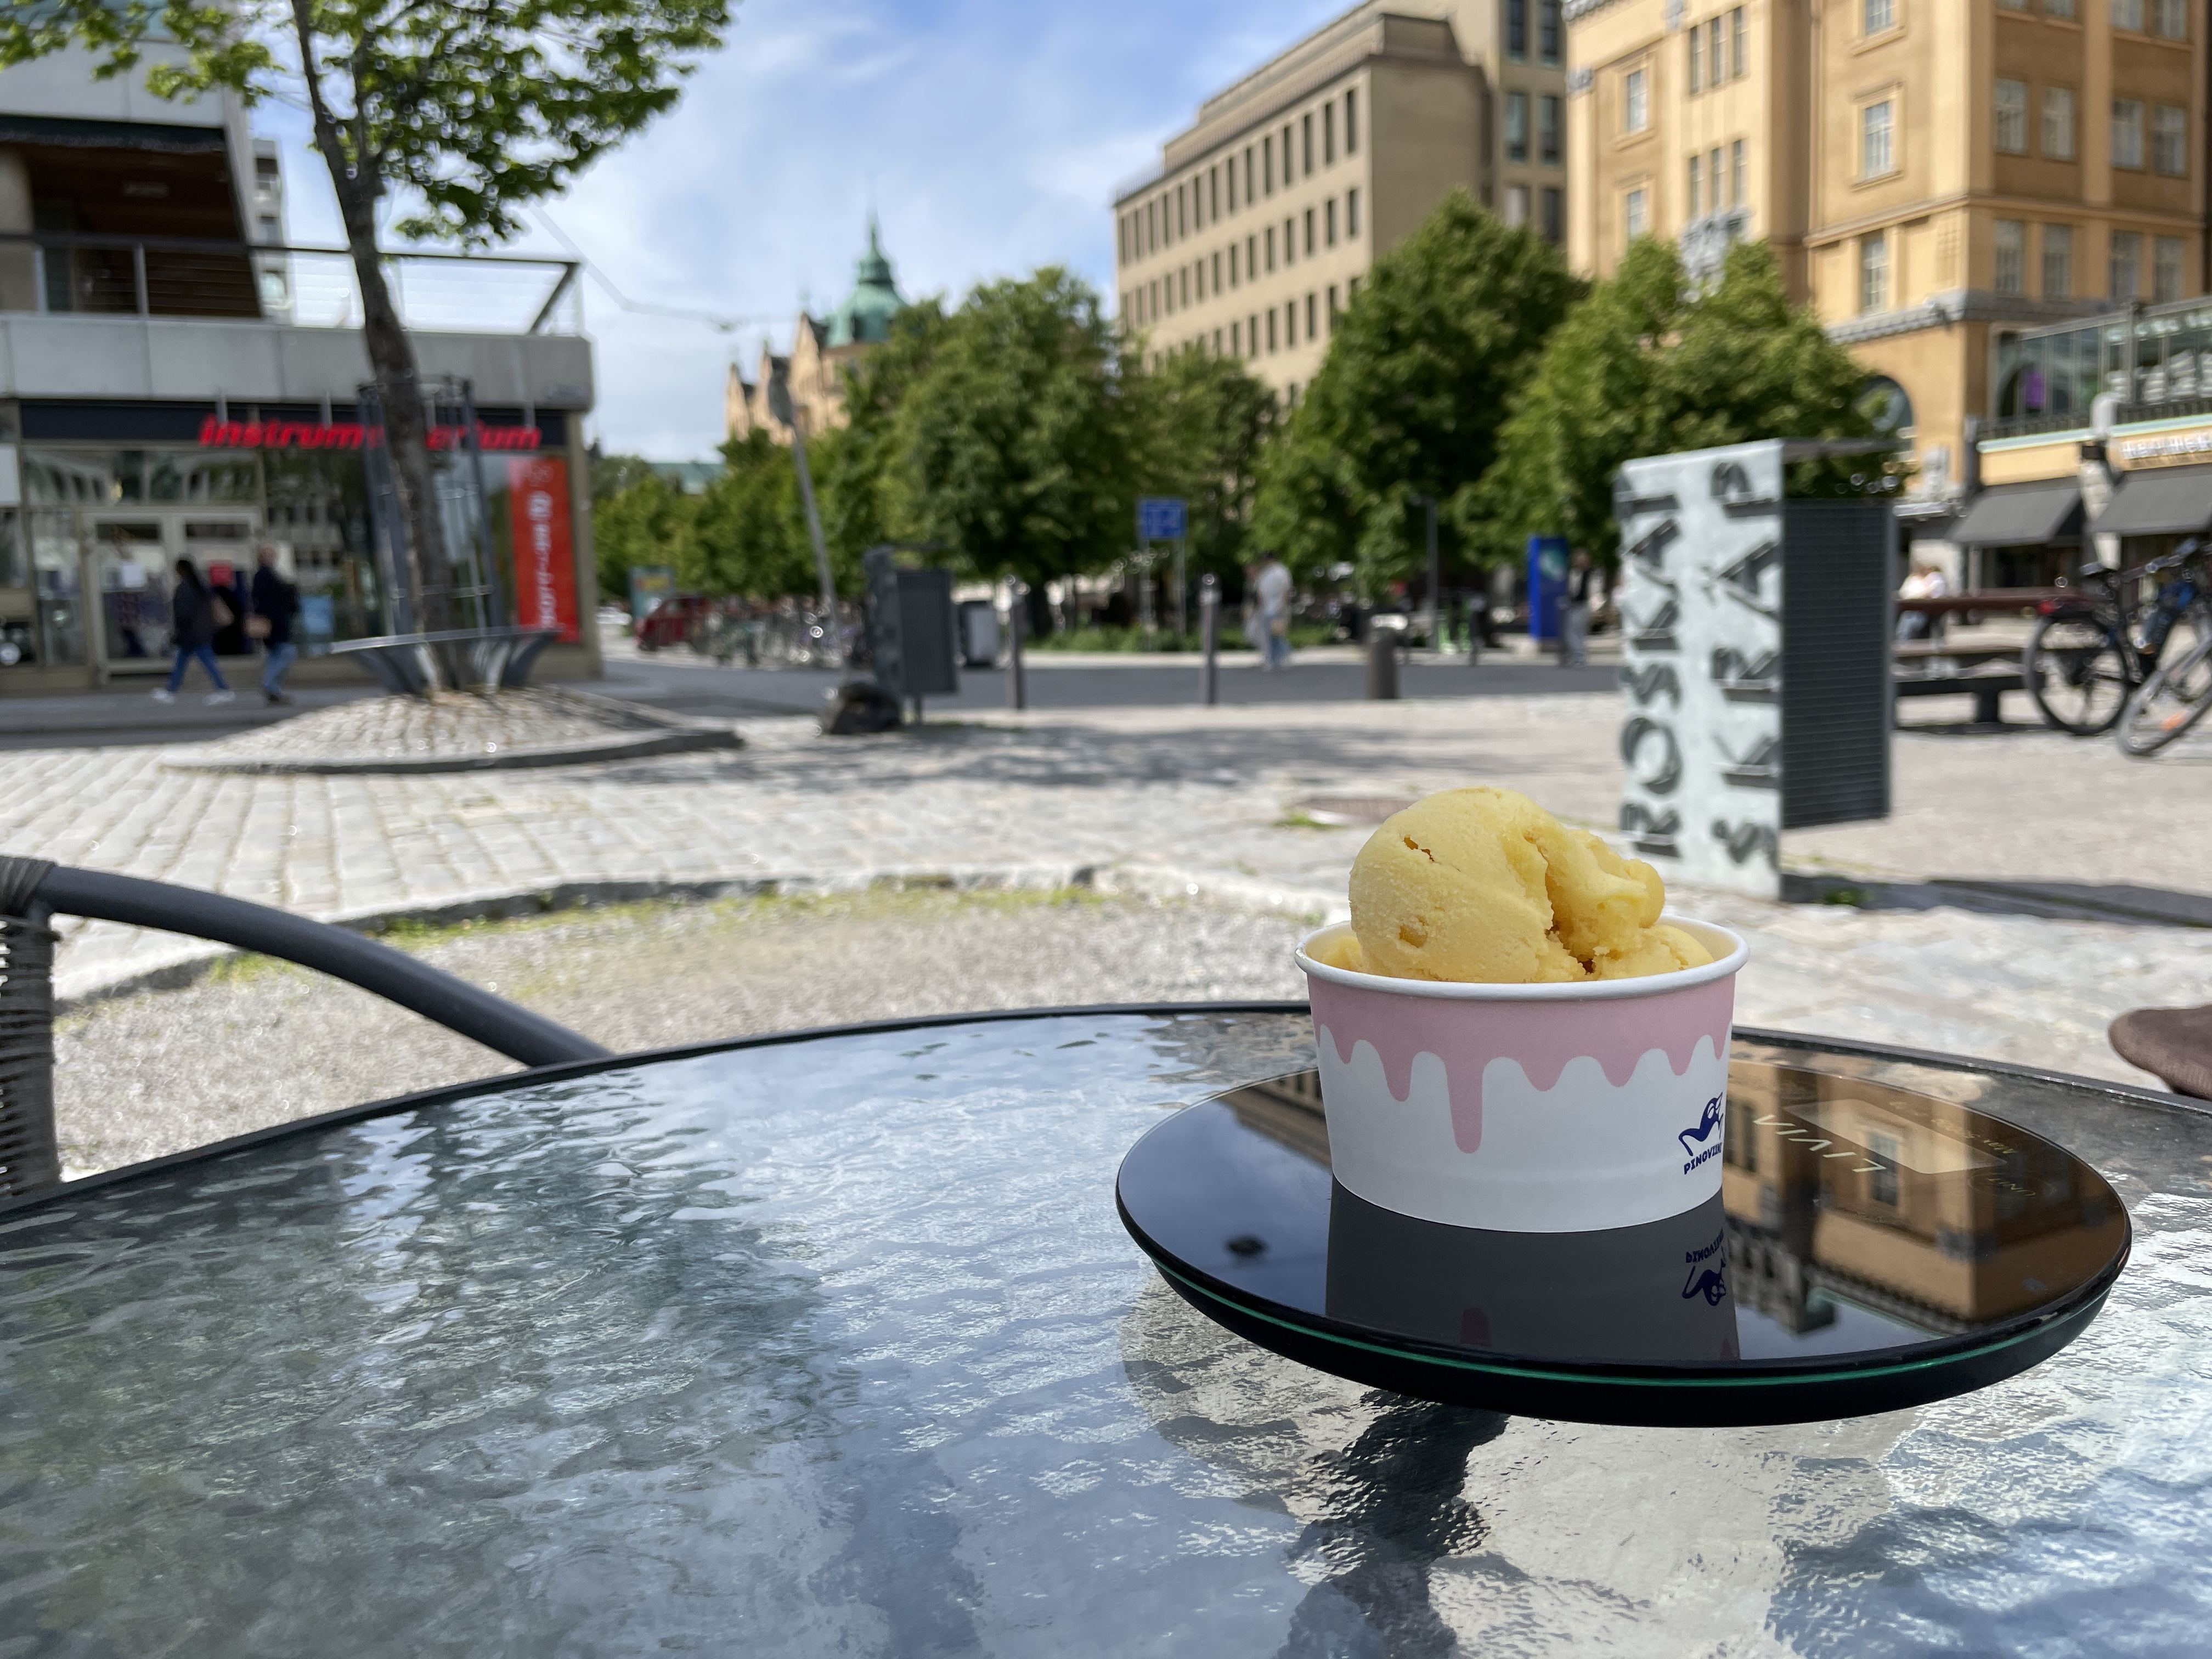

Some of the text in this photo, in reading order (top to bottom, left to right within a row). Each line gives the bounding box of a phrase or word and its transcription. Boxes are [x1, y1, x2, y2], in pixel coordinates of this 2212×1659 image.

[198, 414, 542, 451] instrumarum
[1615, 466, 1681, 859] ROSKAT
[1703, 460, 1781, 873] SKRÄP
